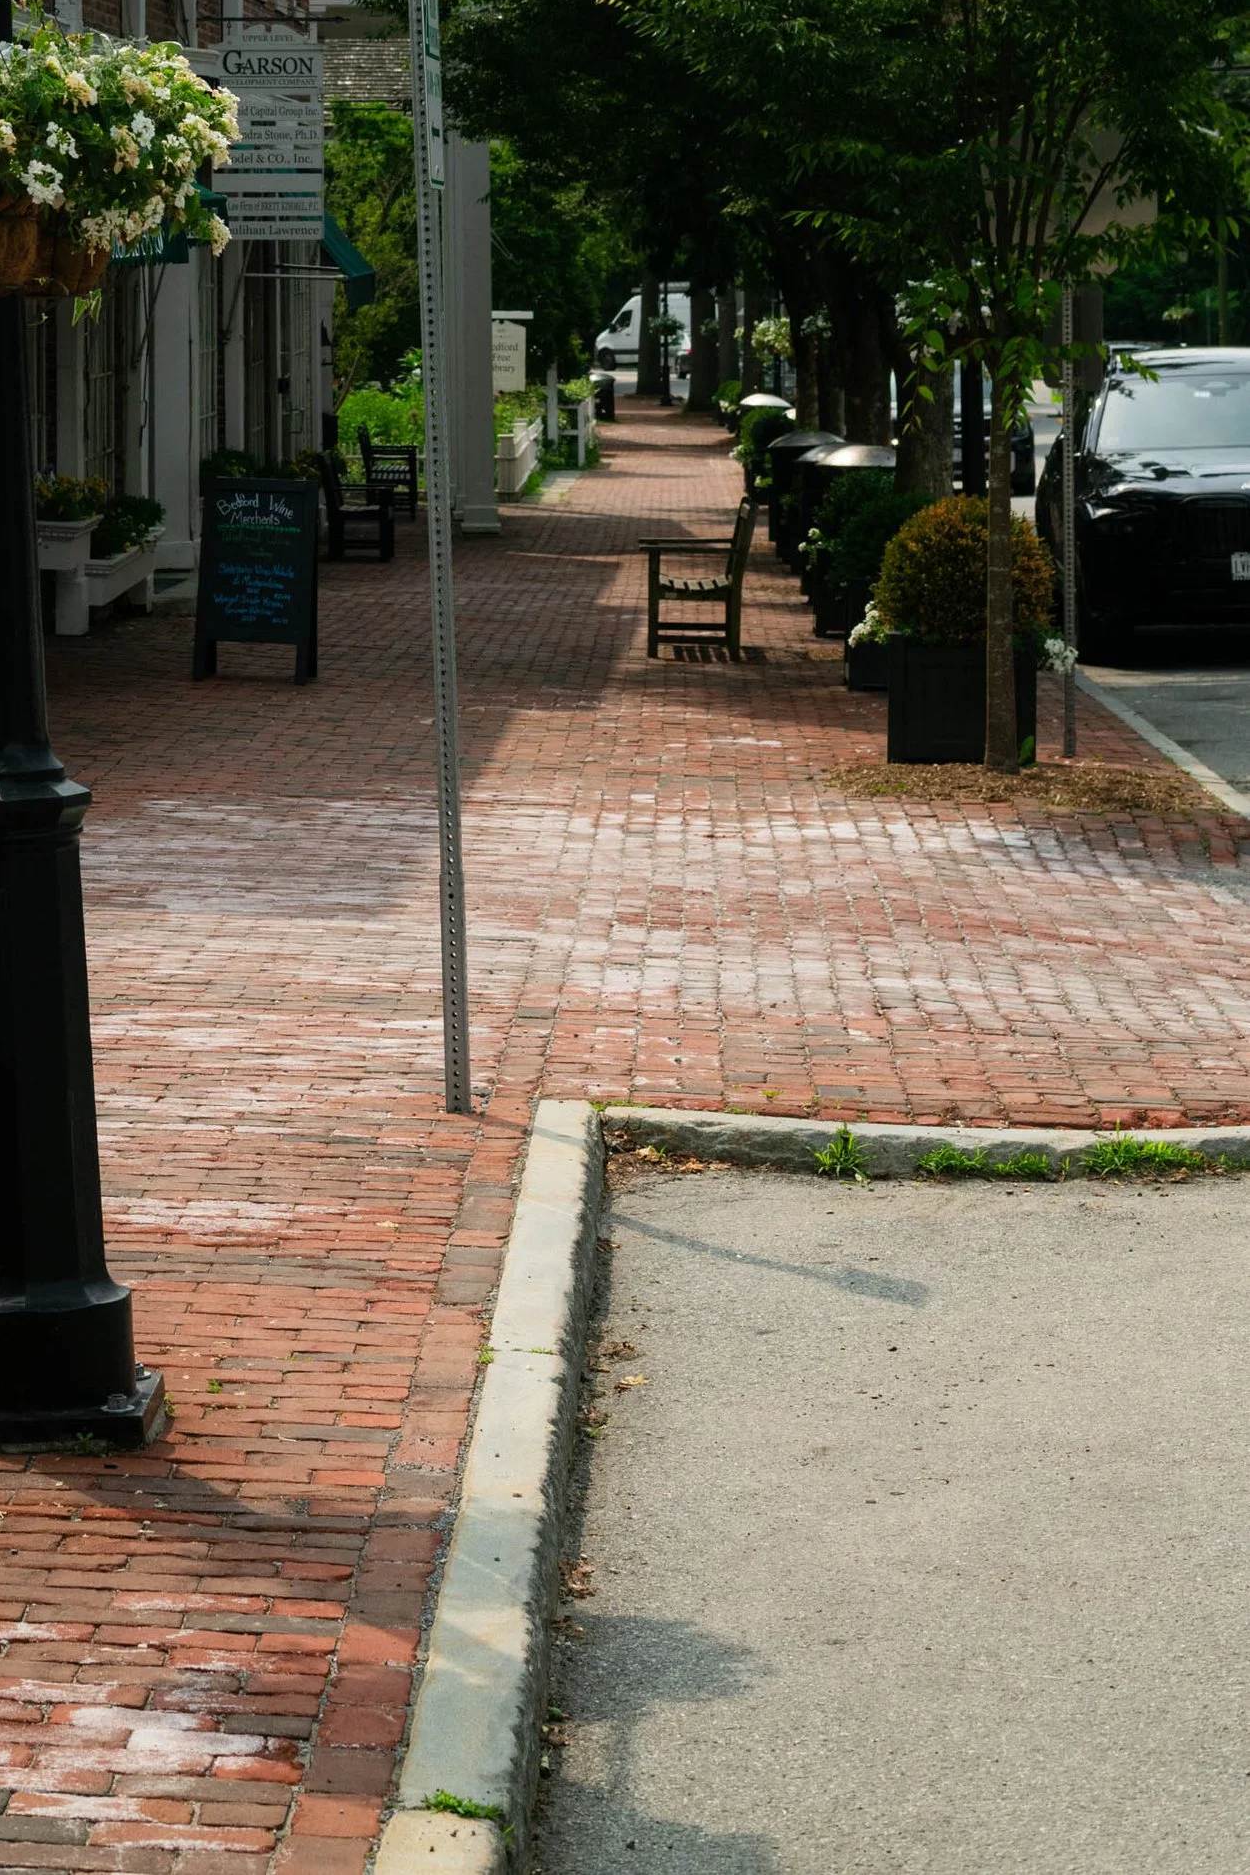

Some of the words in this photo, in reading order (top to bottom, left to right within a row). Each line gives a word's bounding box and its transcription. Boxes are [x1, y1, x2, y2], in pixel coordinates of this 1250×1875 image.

[242, 34, 267, 43] UPPER
[270, 34, 296, 43] LEVEL
[222, 49, 314, 75] GARSON
[220, 78, 276, 86] DEVELOPMENT
[278, 78, 316, 86] COMPANY
[250, 105, 277, 119] Capital
[278, 105, 303, 119] Group
[305, 106, 320, 116] Inc.
[265, 129, 293, 141] Stone,
[295, 129, 320, 140] Ph.D.
[231, 153, 254, 164] odel
[256, 154, 265, 164] &
[294, 153, 314, 164] Inc.
[269, 225, 320, 235] Lawrence
[491, 341, 518, 352] edford
[216, 492, 259, 516] Bedford
[269, 494, 294, 520] Wine
[230, 510, 281, 526] Merchants
